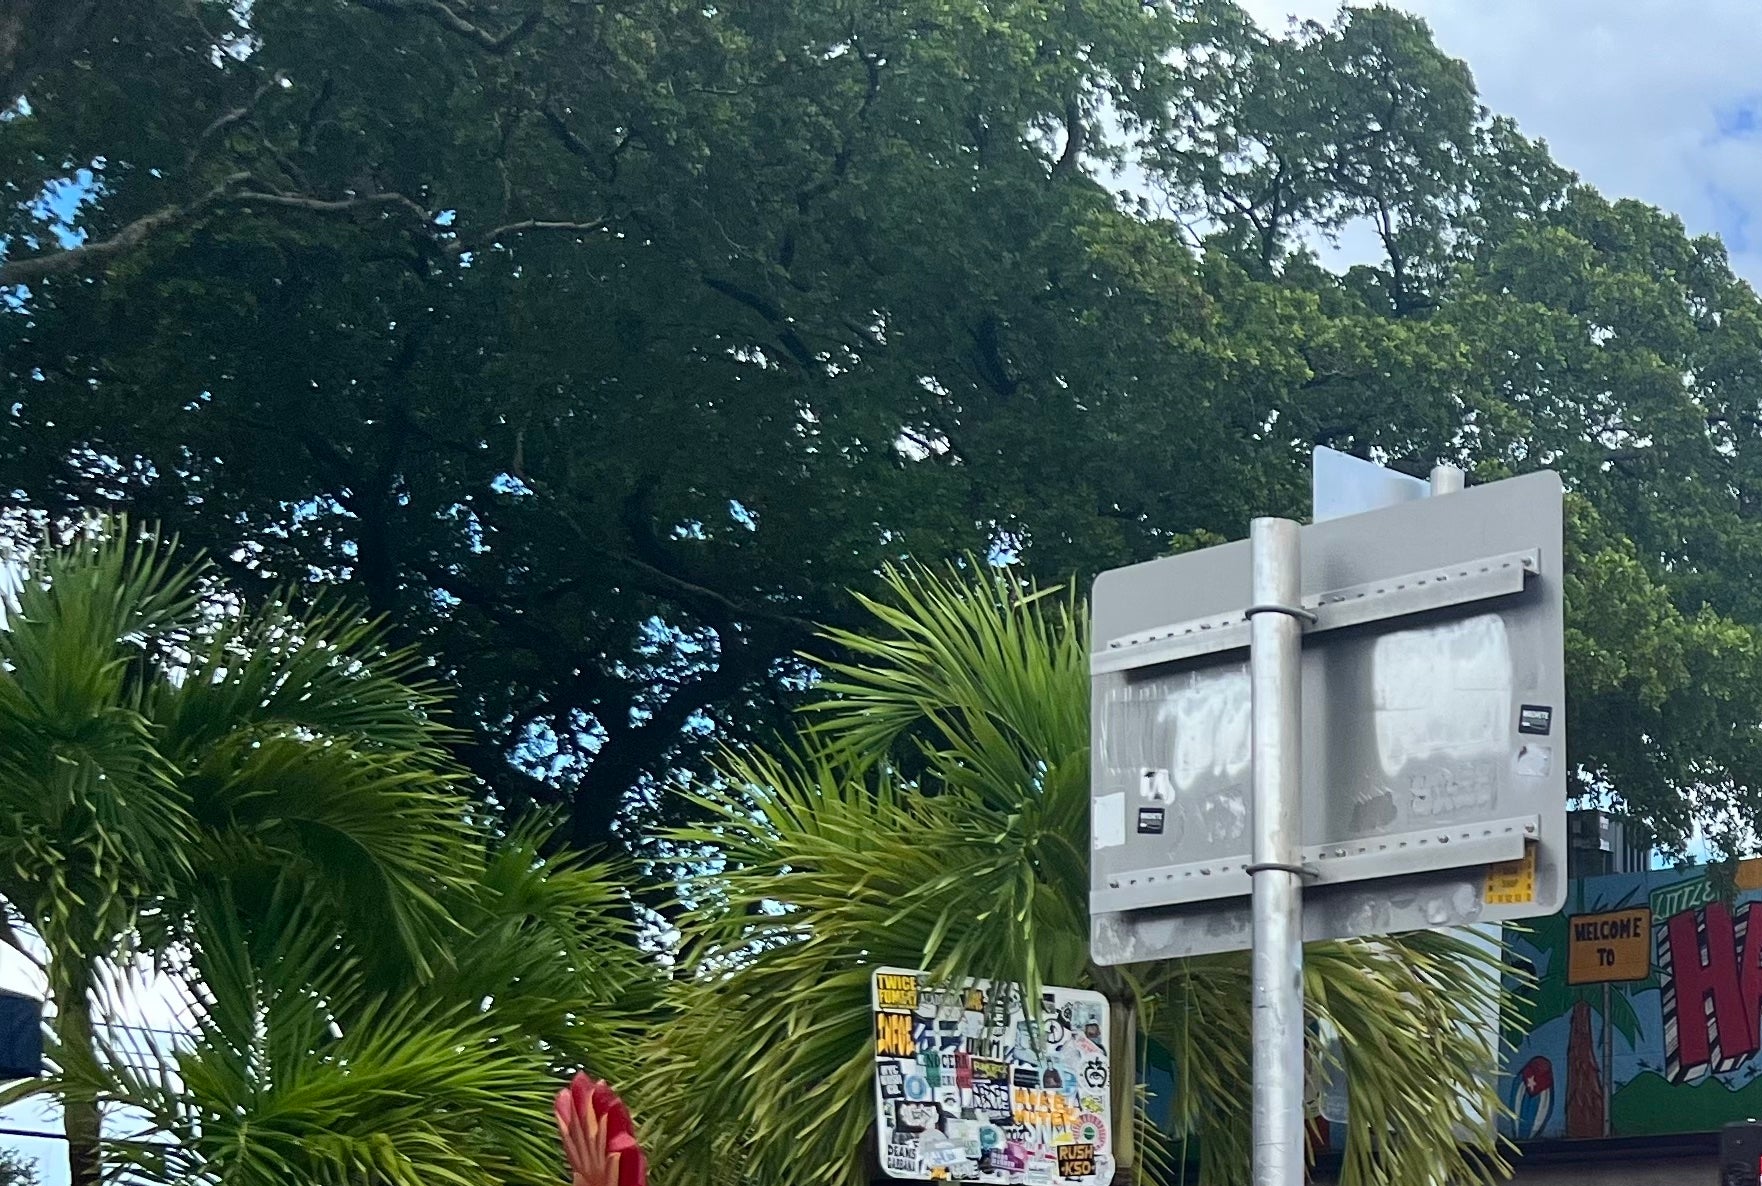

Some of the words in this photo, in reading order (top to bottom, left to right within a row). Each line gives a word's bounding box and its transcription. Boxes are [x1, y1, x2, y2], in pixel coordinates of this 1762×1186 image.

[1574, 917, 1642, 942] WELCOME
[1597, 947, 1615, 966] TO
[1059, 1145, 1092, 1161] RUSH
